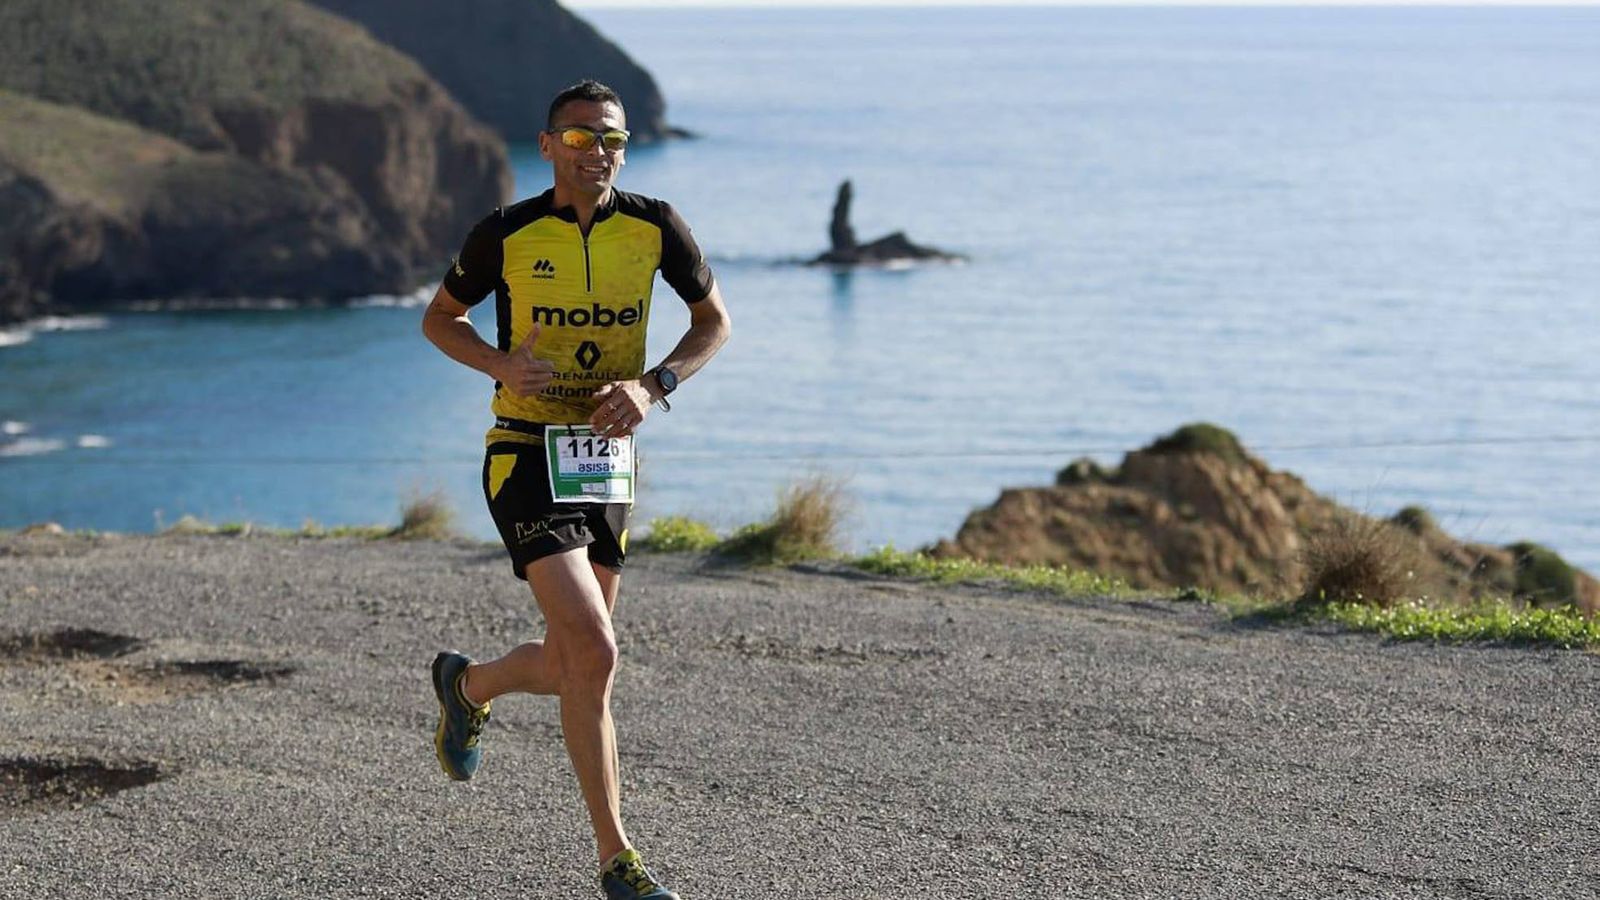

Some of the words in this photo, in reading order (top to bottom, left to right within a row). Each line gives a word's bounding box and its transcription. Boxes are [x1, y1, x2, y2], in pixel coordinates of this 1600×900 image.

[532, 299, 643, 327] mobel
[551, 371, 622, 380] RENAULT
[568, 438, 620, 458] 1126
